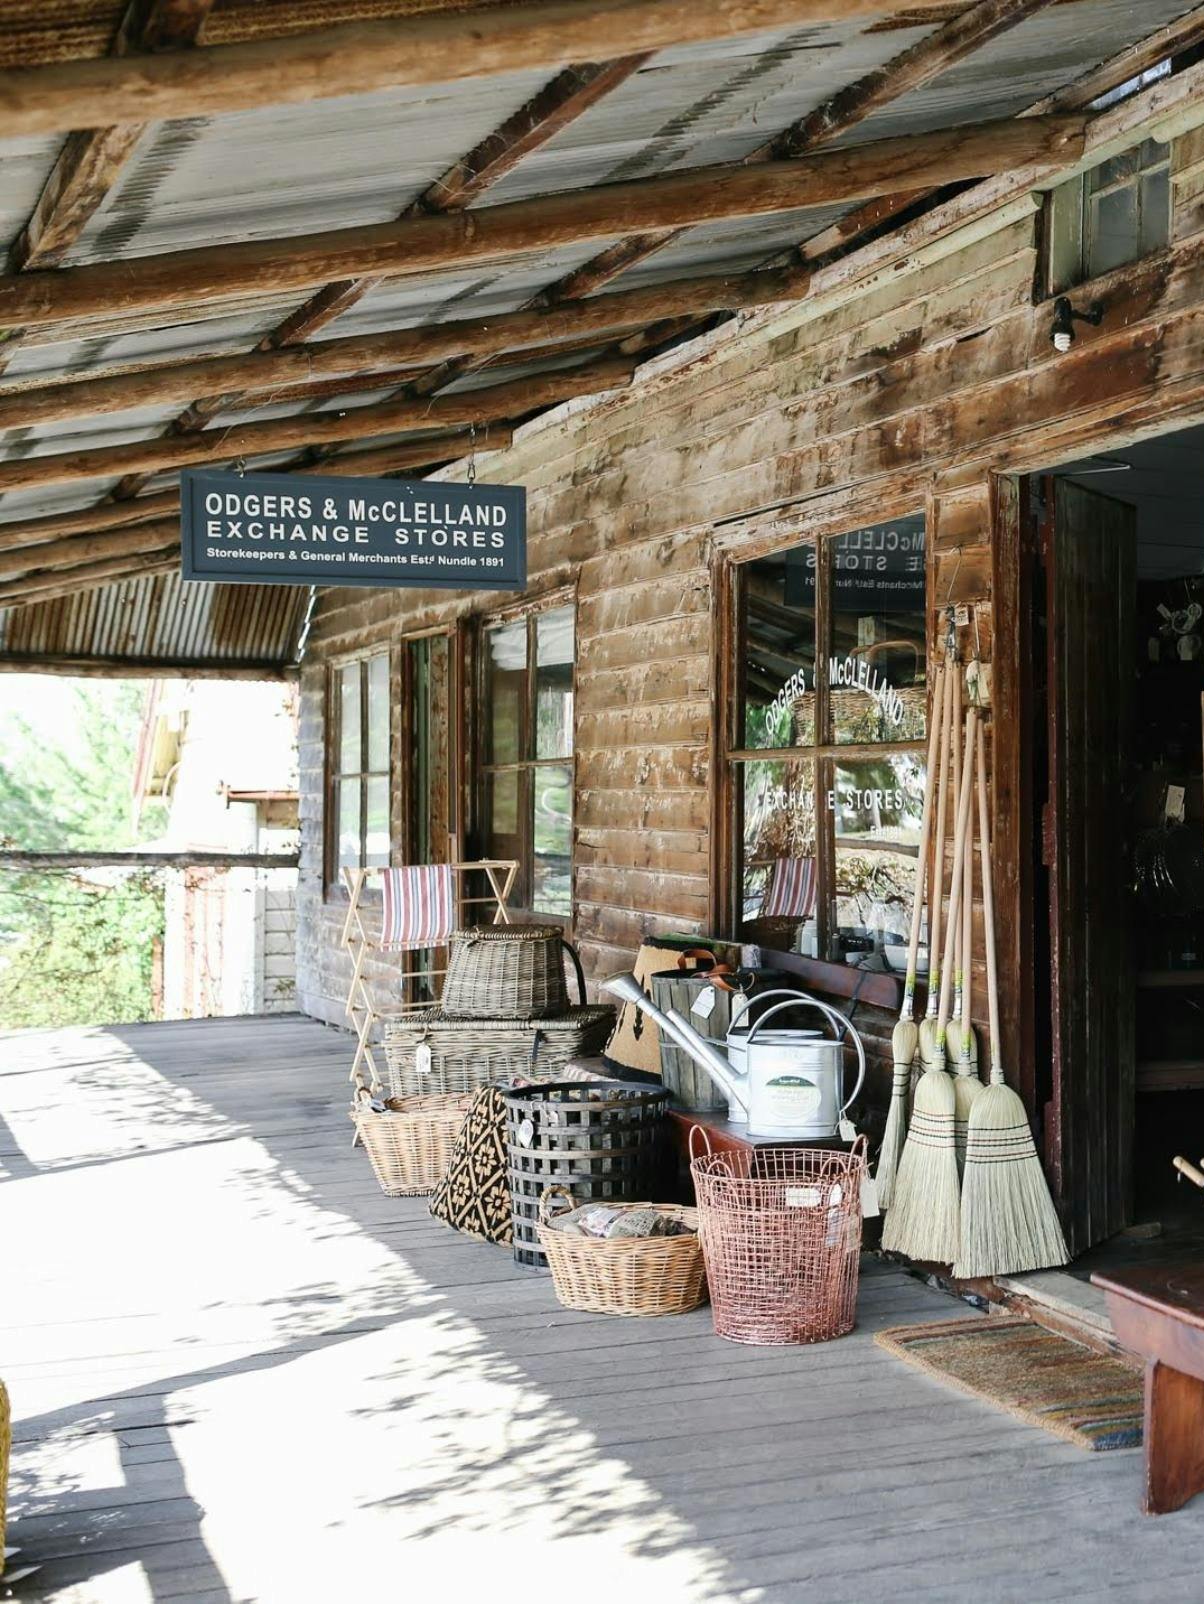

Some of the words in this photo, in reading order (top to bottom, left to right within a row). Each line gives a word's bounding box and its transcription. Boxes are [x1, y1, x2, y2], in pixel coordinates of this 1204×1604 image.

[205, 492, 313, 519] ODGERS
[322, 498, 338, 519] &
[349, 499, 507, 527] McCLELLAND
[206, 520, 370, 544] EXCHANGE
[394, 527, 505, 549] STORES
[206, 547, 285, 561] Storekeepers
[288, 550, 298, 560] &
[300, 551, 346, 562] General
[348, 552, 407, 564] Merchants
[438, 555, 477, 566] Nundle
[479, 557, 504, 567] 1891
[765, 668, 806, 735] ODGERS
[829, 656, 904, 726] McCLELLAND
[765, 789, 835, 810] EXCHANE
[846, 788, 904, 810] STORES
